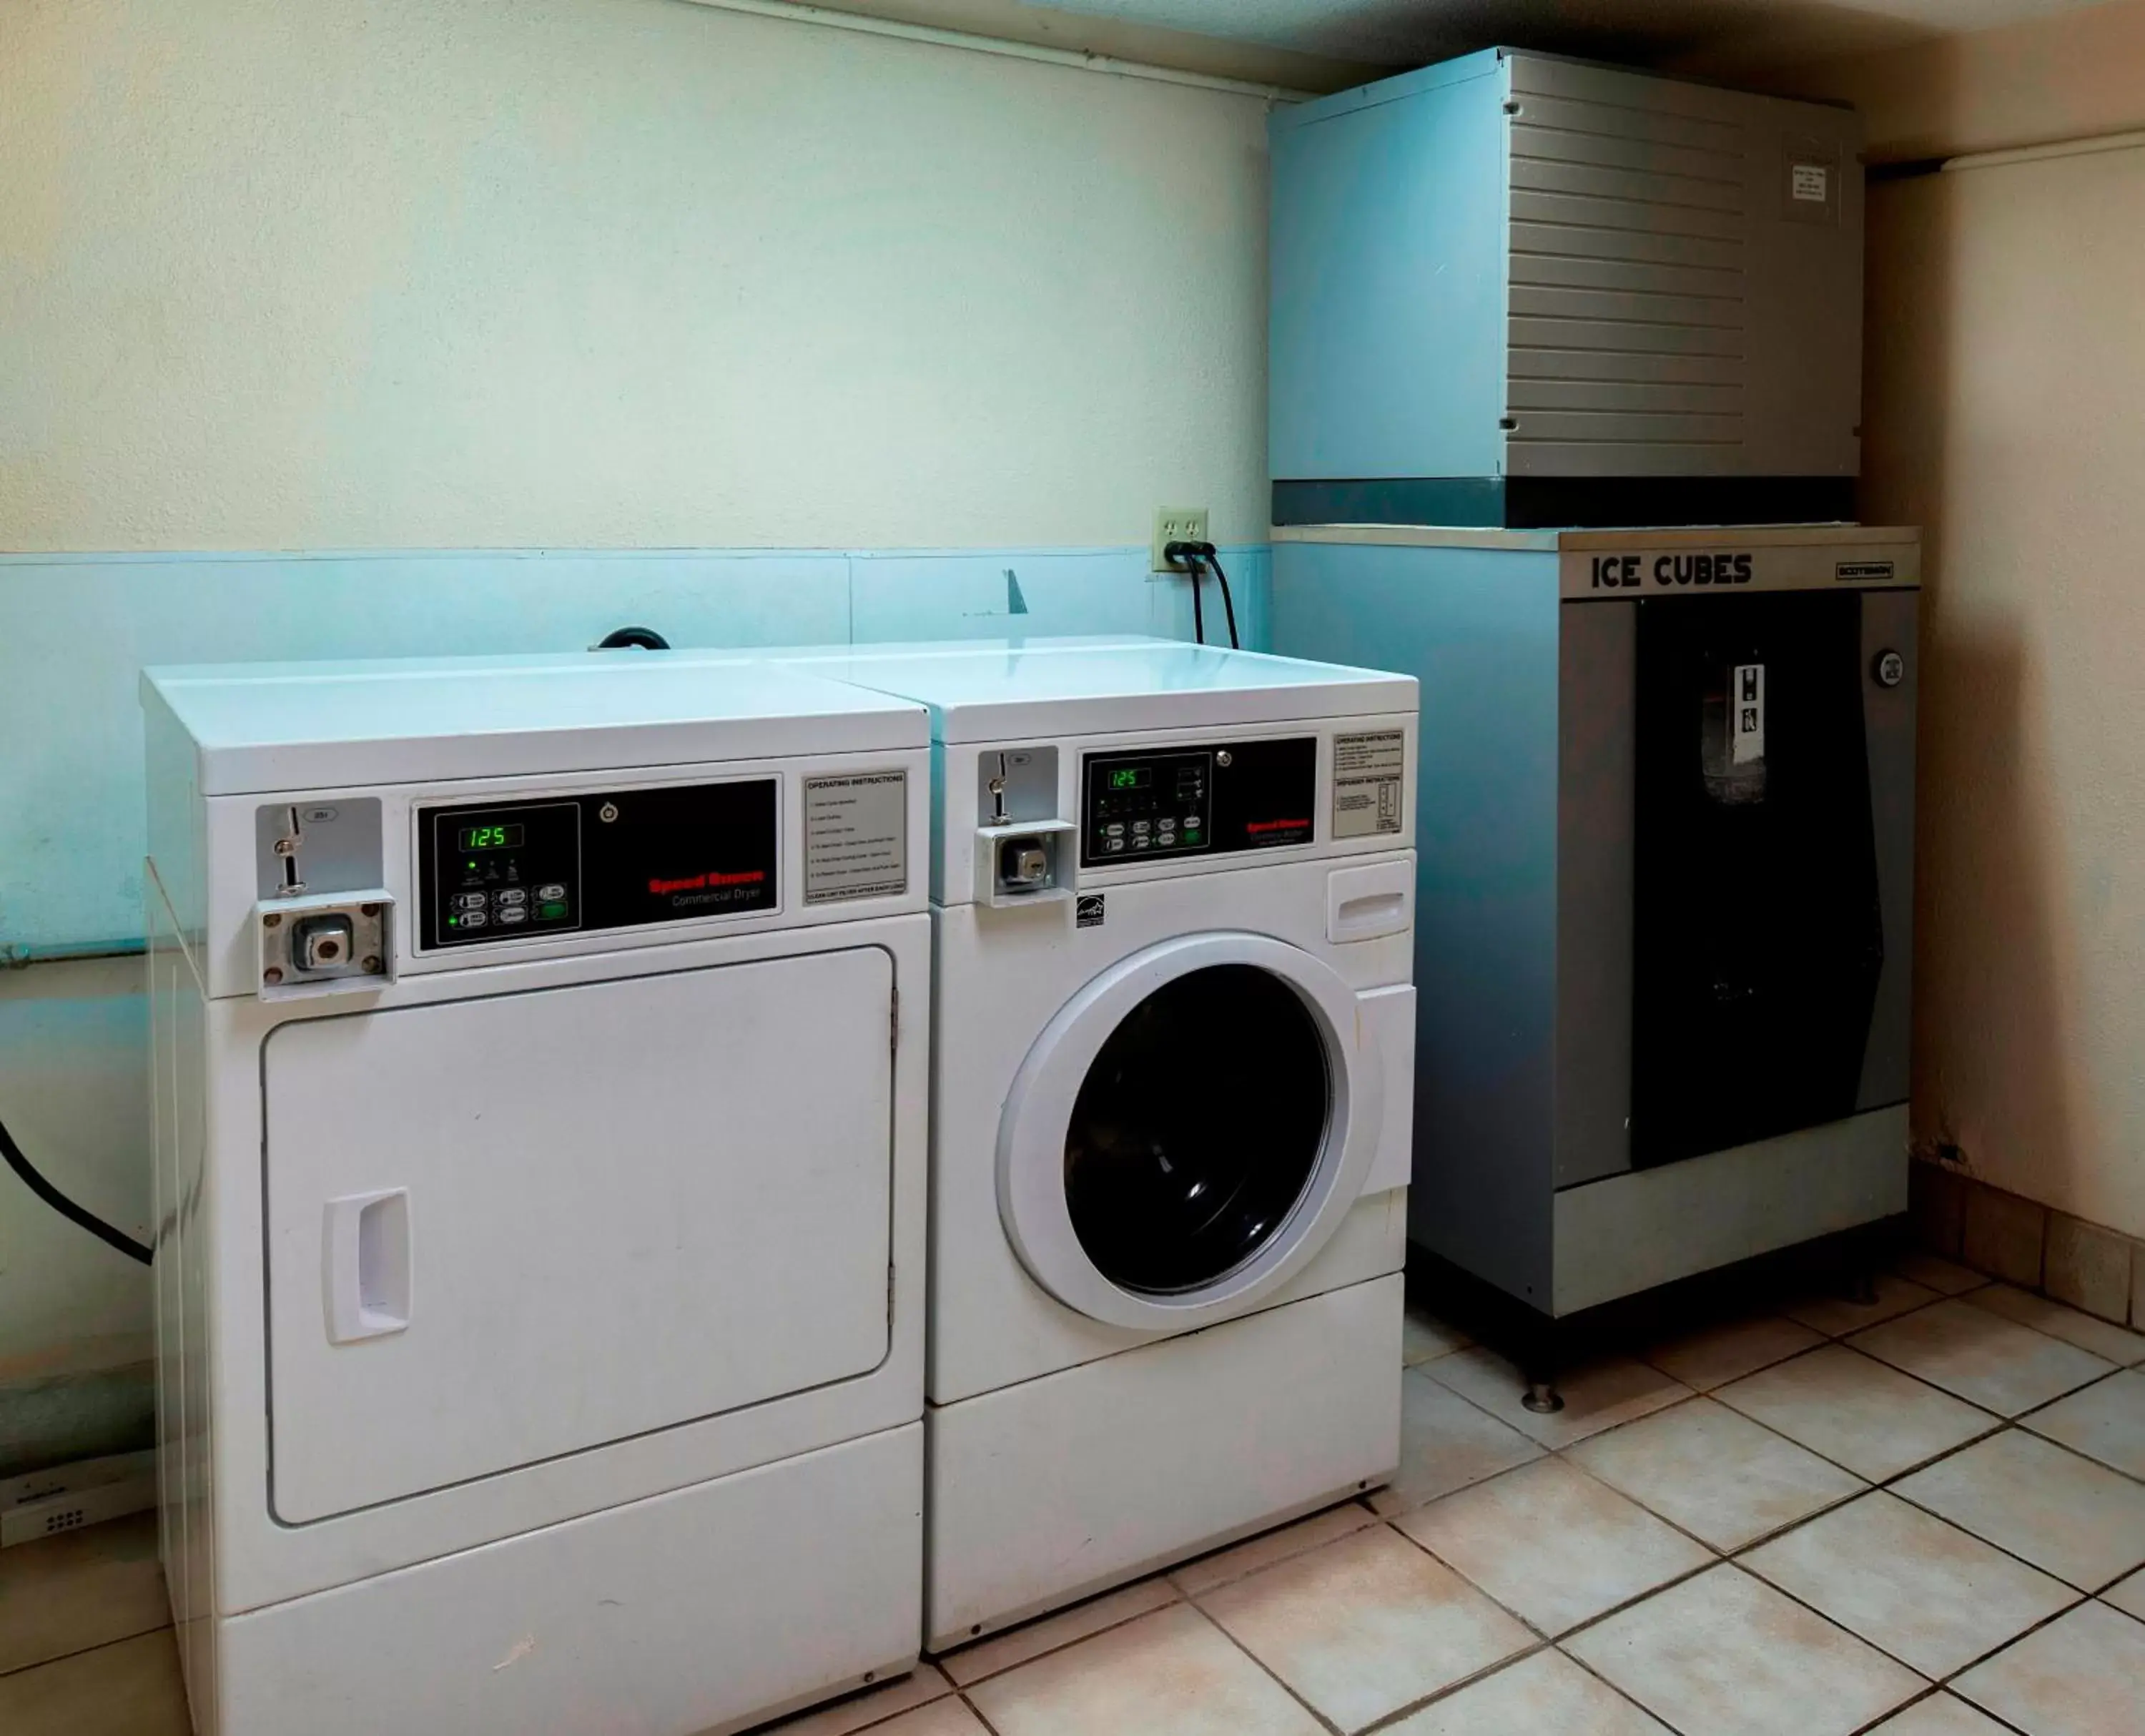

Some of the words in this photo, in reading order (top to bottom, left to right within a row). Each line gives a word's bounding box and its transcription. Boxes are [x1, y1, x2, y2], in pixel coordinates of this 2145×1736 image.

[1592, 556, 1641, 588] ICE
[1654, 553, 1752, 586] CUBES
[807, 779, 850, 790] OPERATING
[851, 774, 904, 786] INSTRUCTIONS
[470, 827, 505, 847] 125
[672, 890, 731, 907] Commercial
[734, 888, 761, 901] Dryer
